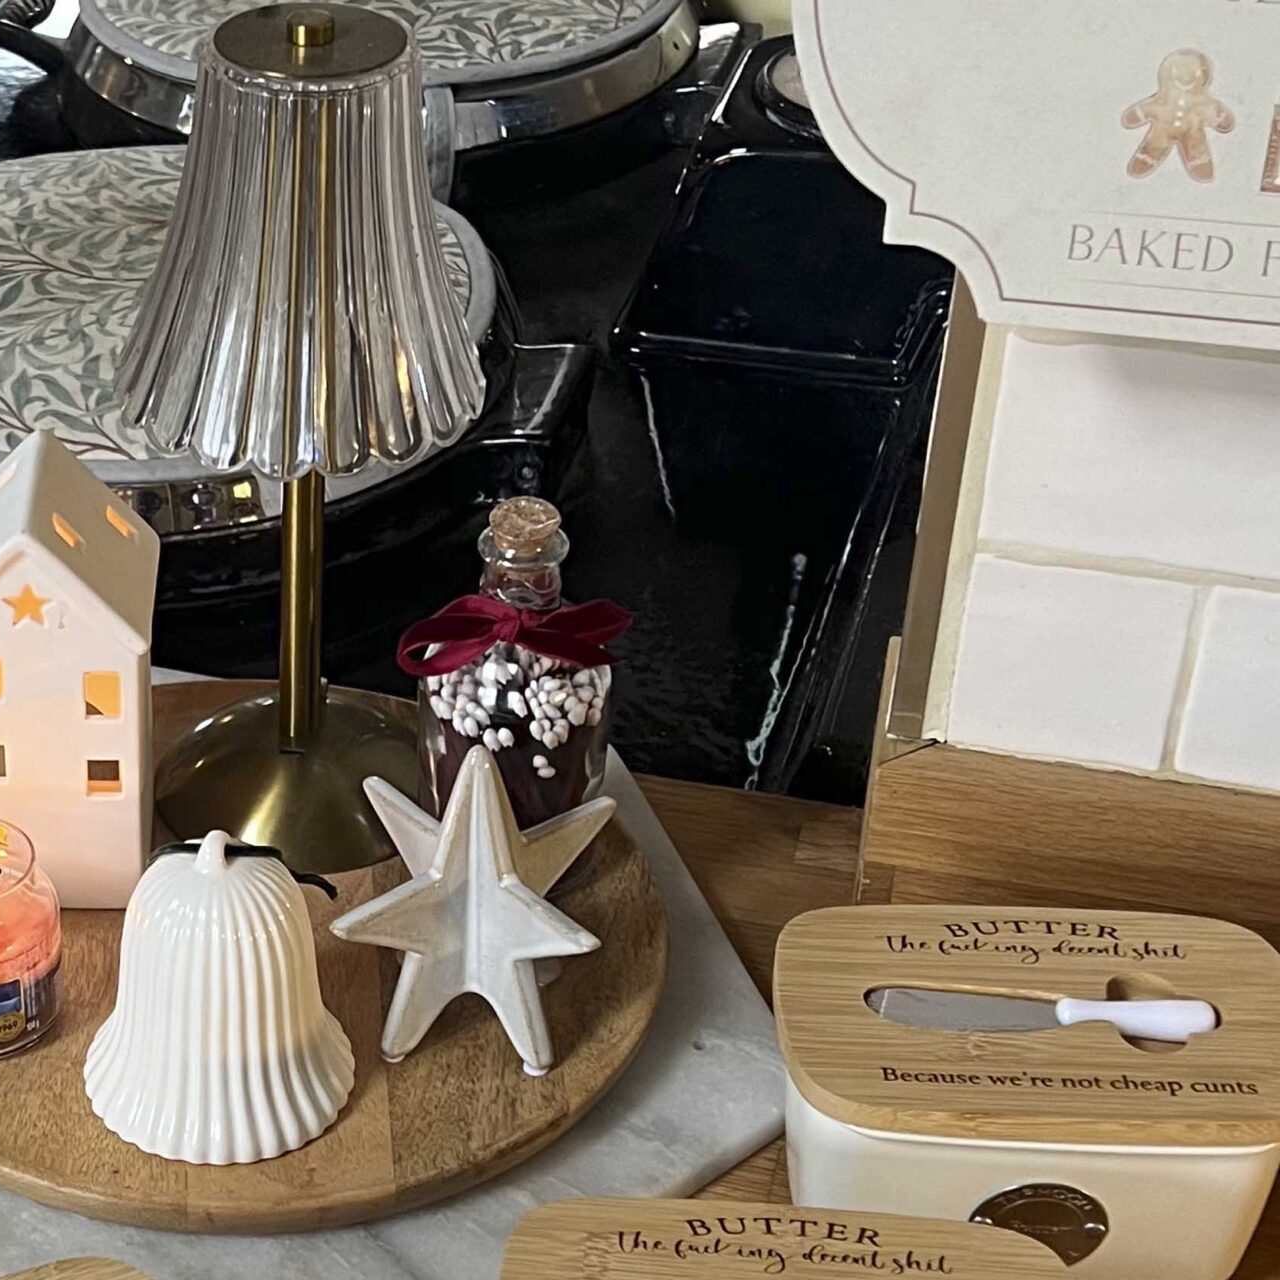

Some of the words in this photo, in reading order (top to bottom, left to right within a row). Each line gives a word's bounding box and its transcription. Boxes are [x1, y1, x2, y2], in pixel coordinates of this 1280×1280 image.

[1067, 223, 1235, 274] BAKED
[944, 920, 1121, 940] BUTTER
[882, 1066, 982, 1087] Because
[986, 1072, 1055, 1090] we're
[1060, 1076, 1106, 1091] not
[1109, 1075, 1185, 1096] cheap
[1190, 1080, 1260, 1096] cunts
[687, 1217, 882, 1247] BUTTER
